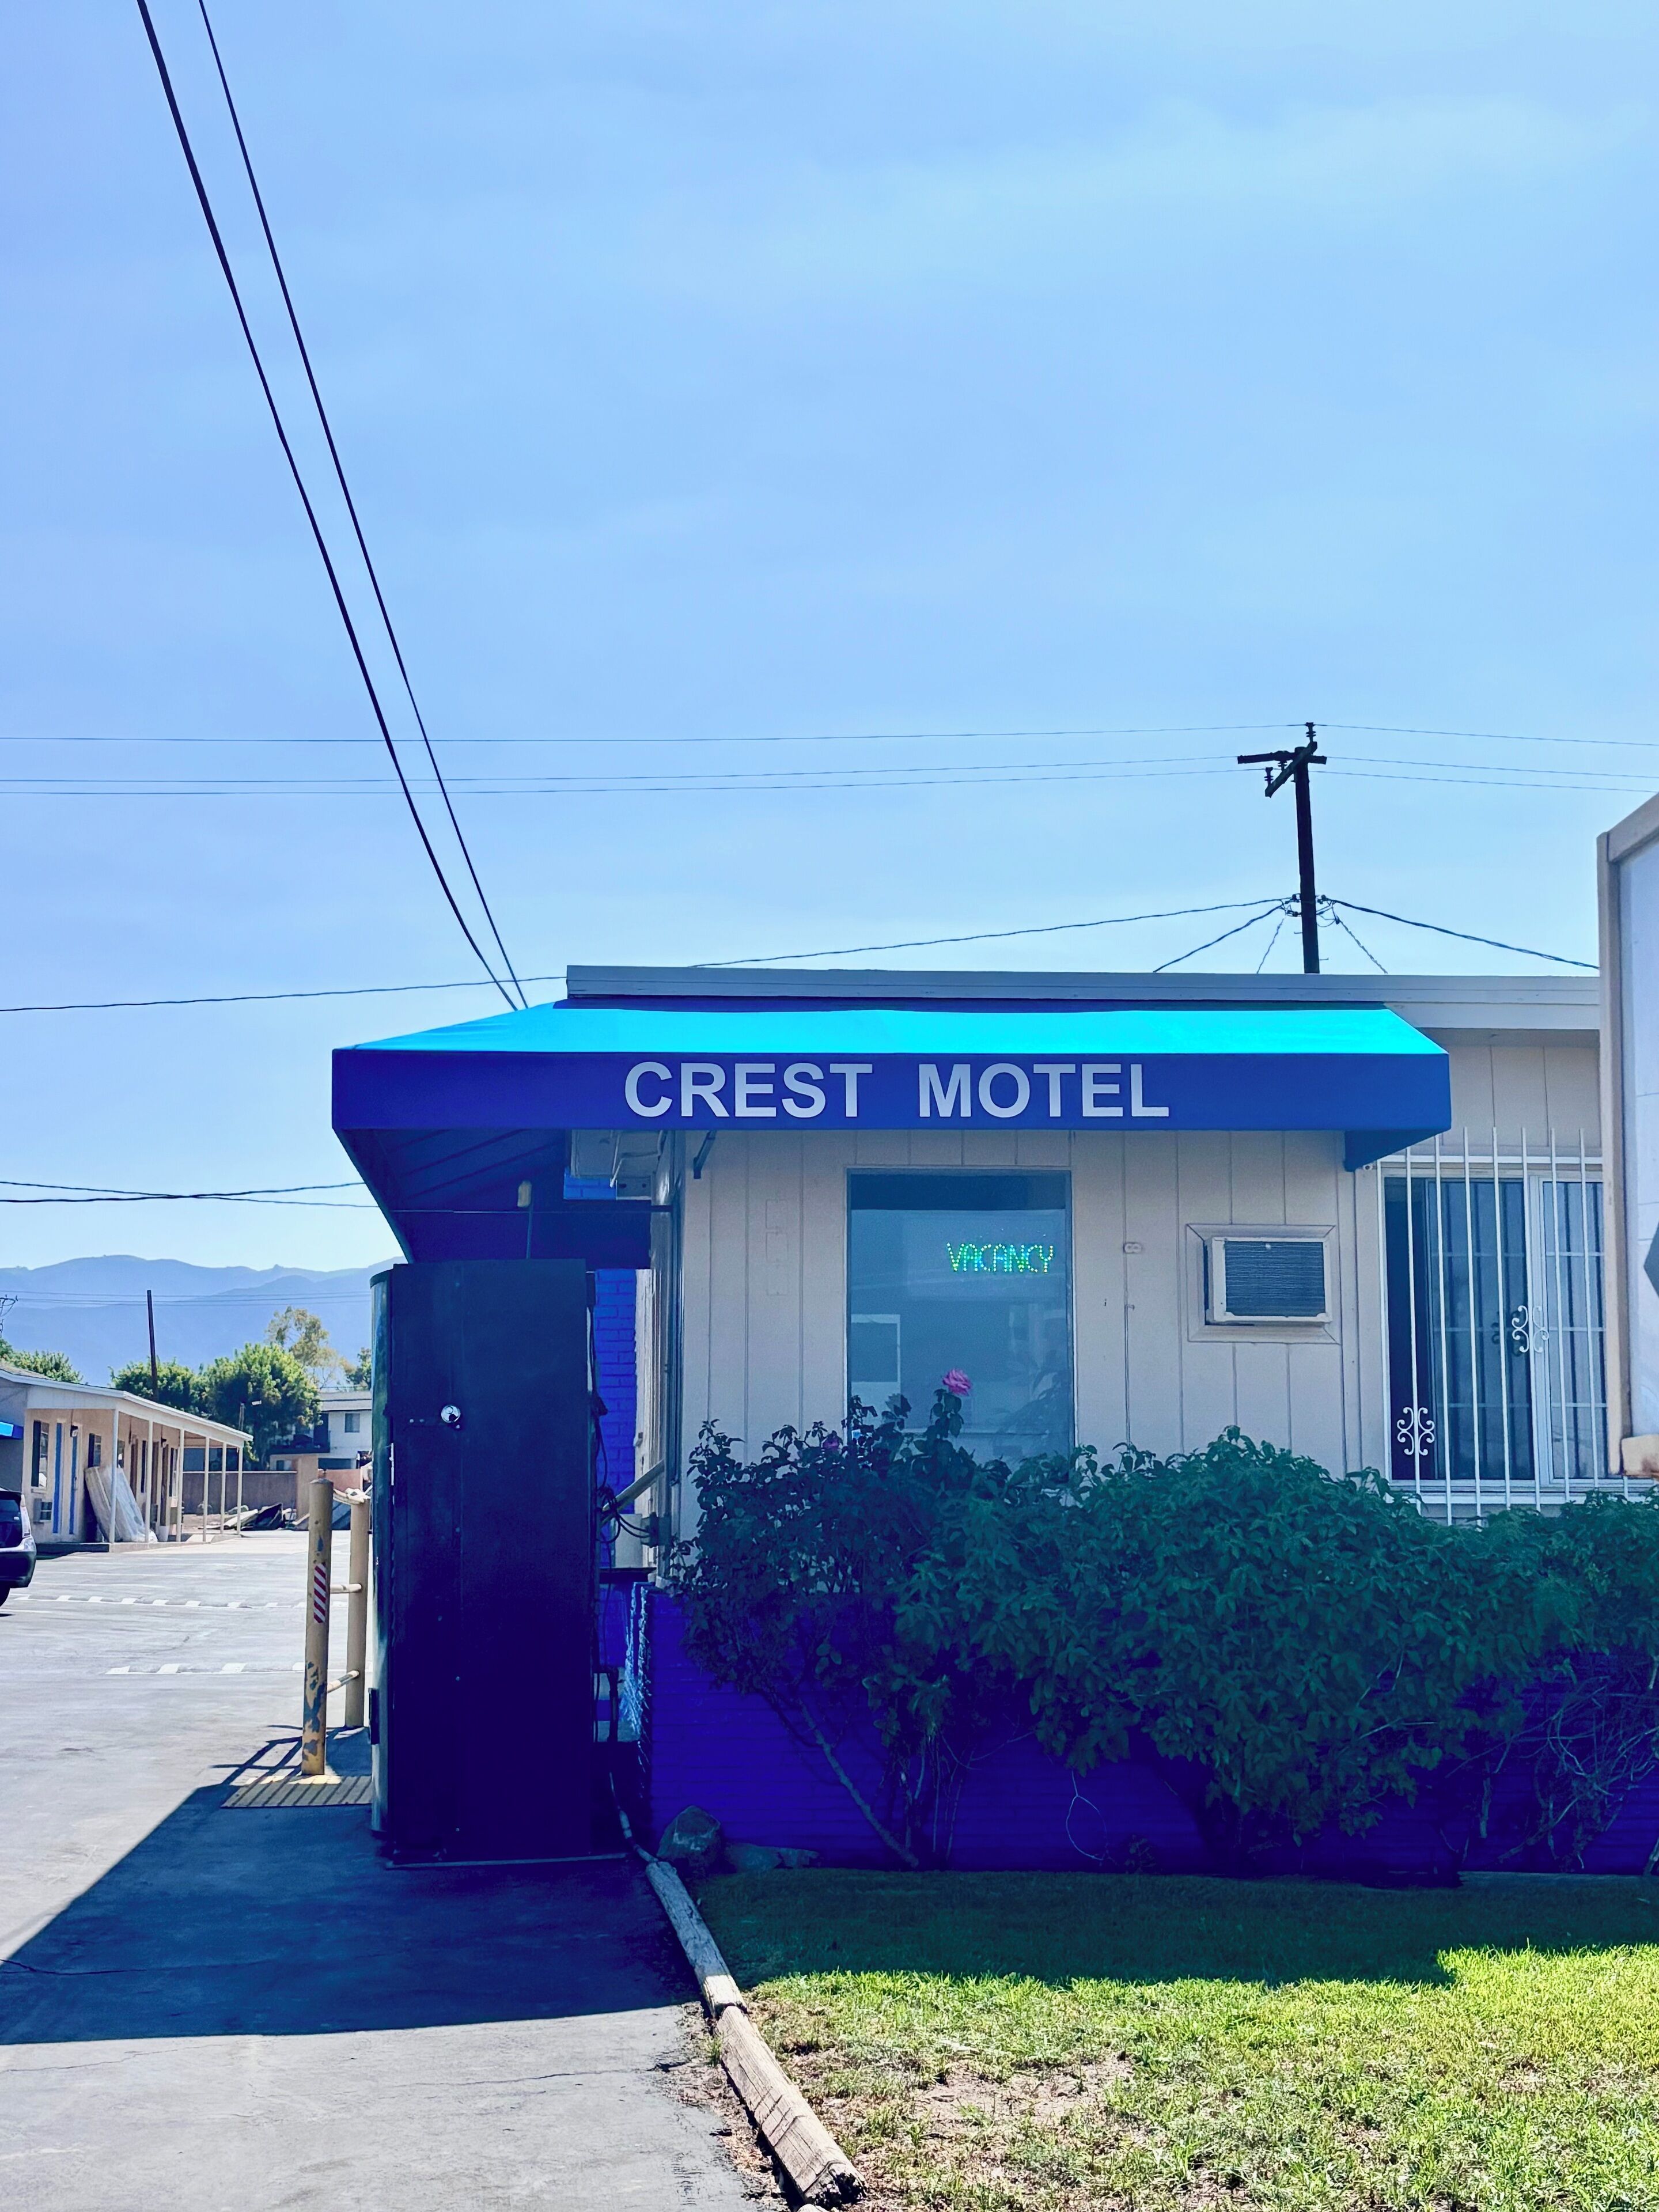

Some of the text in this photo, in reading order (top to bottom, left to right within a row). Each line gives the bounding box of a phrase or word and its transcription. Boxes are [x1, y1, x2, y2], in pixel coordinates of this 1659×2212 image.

[624, 1061, 1170, 1118] CREST MOTEL
[946, 1243, 1054, 1273] VACANCY
